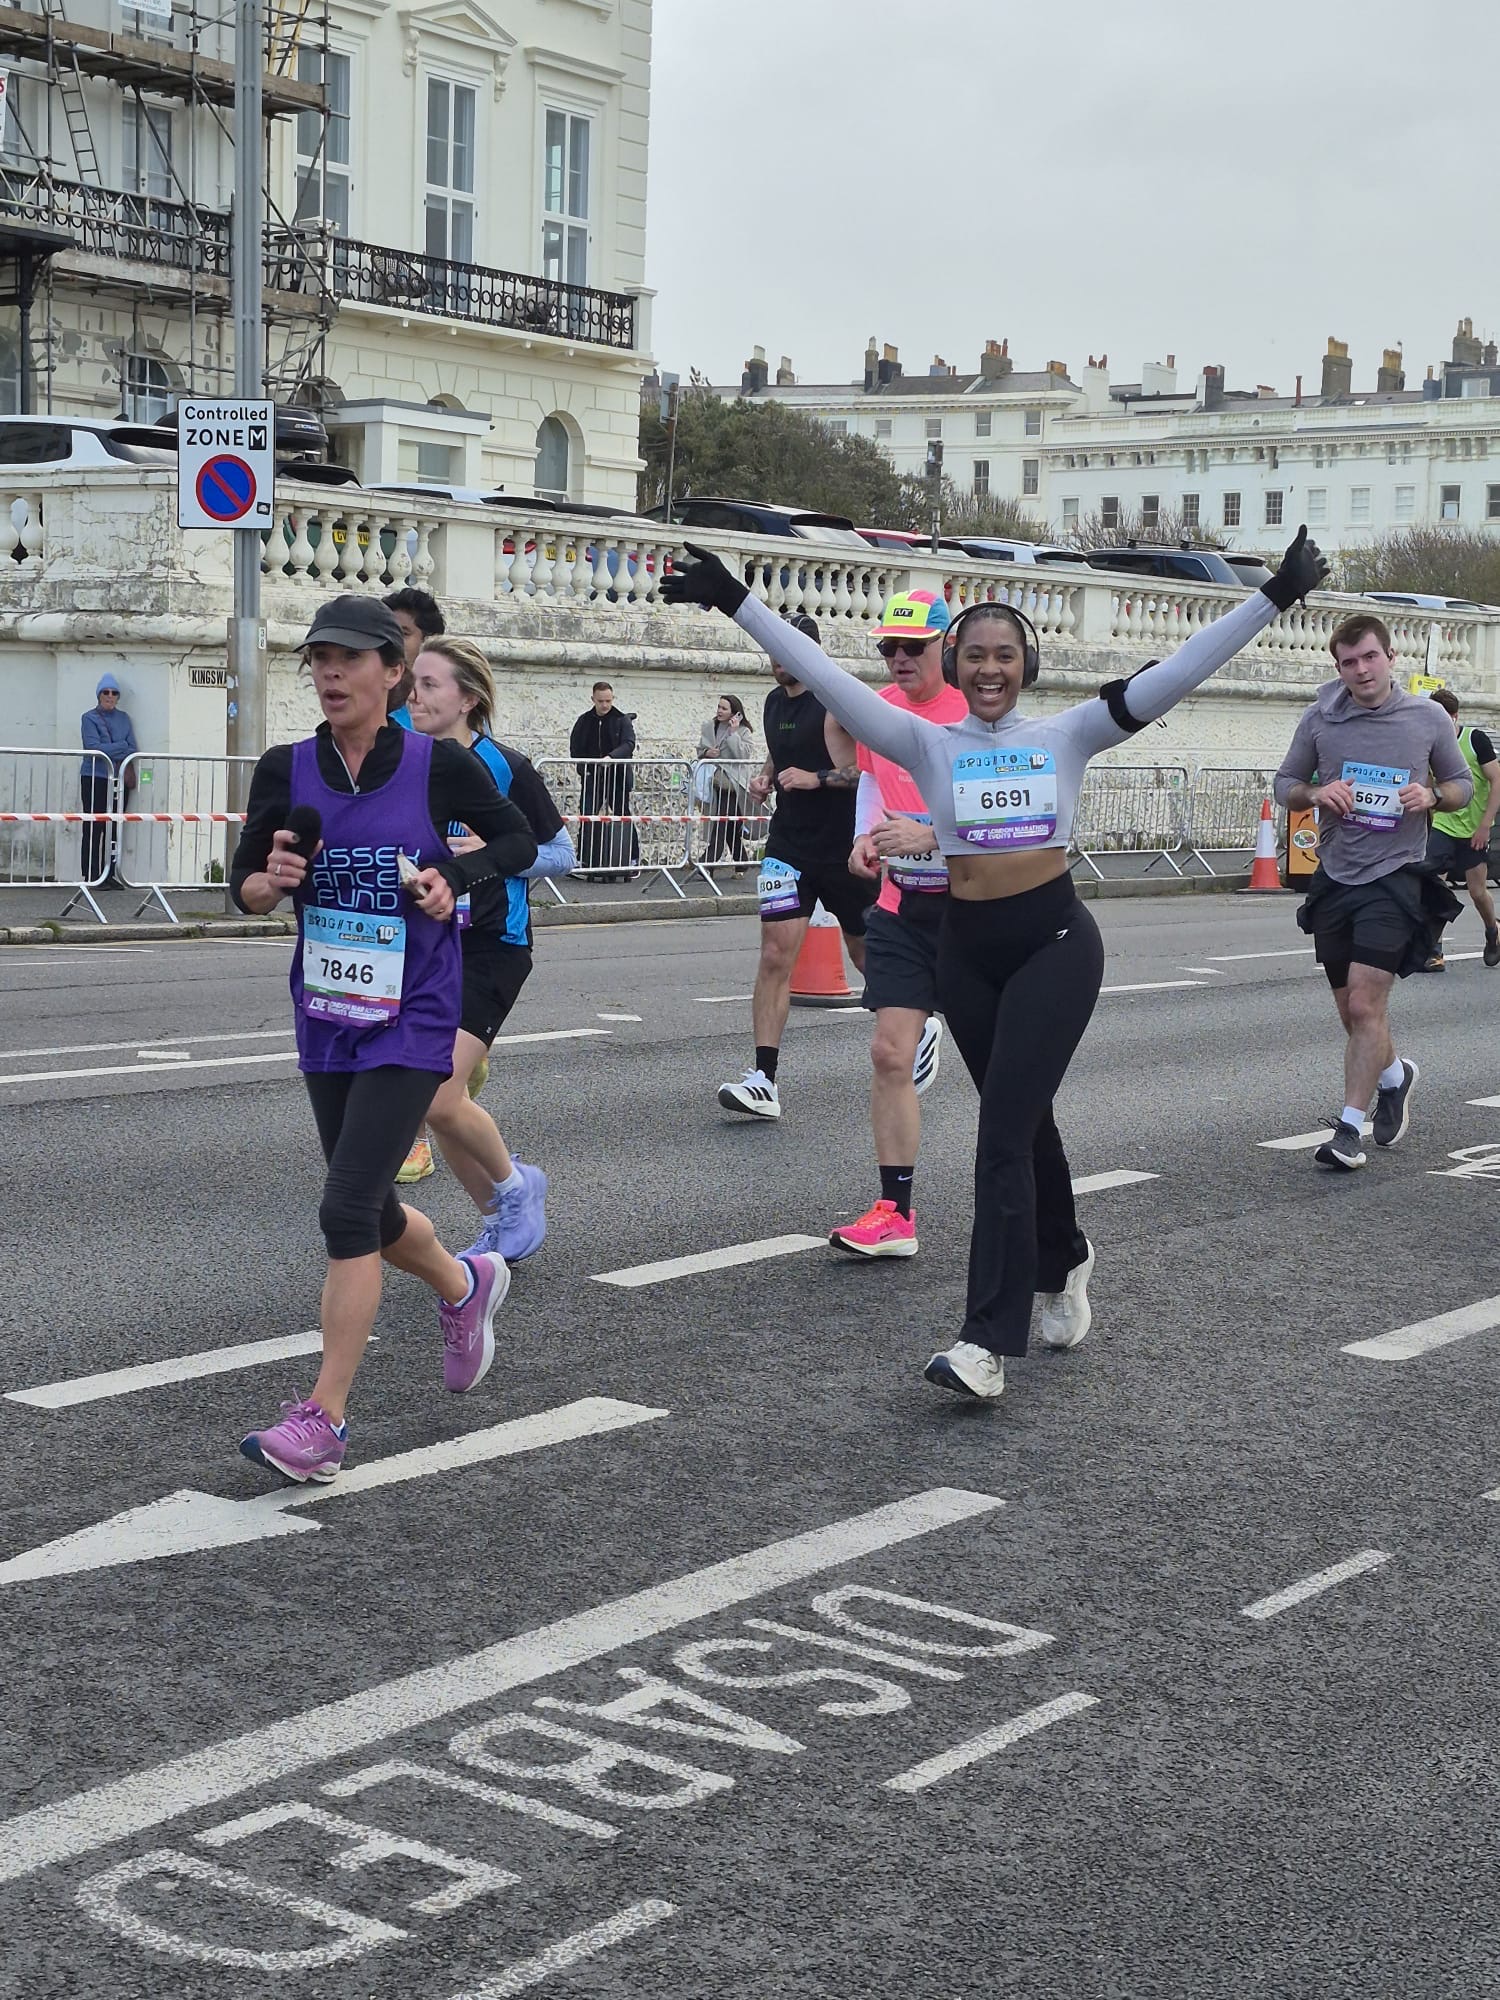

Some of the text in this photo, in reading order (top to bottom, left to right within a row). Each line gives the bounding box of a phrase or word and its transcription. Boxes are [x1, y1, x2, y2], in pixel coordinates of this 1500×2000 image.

[185, 405, 268, 421] Controlled
[186, 428, 266, 448] ZONE M
[959, 786, 965, 795] 2
[980, 789, 1031, 810] 6691
[1355, 790, 1390, 807] 5677
[312, 870, 401, 888] ANCE
[317, 889, 398, 910] FUND
[320, 957, 375, 985] 7846
[74, 1582, 1058, 1973] DISABLED
